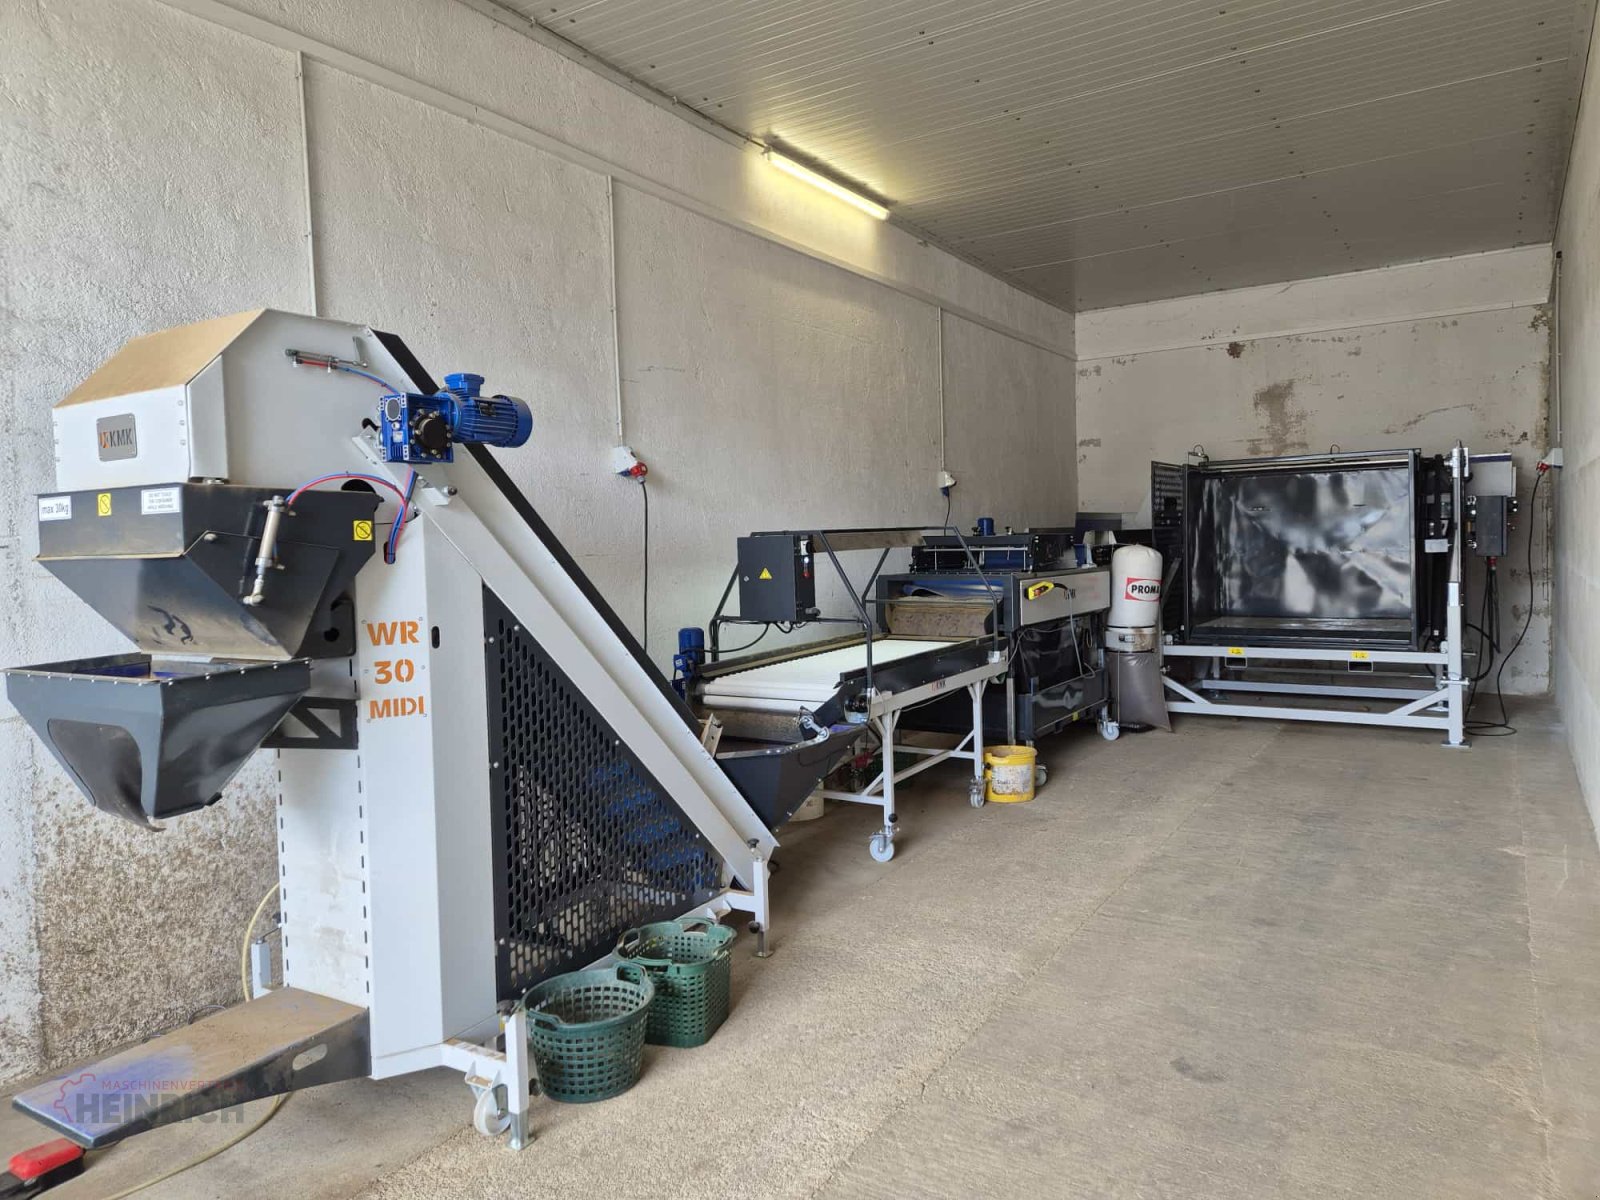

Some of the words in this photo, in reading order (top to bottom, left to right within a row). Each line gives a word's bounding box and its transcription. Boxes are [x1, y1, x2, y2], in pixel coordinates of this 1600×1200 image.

[41, 506, 54, 514] max
[366, 621, 419, 646] WR
[374, 659, 414, 684] 30
[369, 696, 424, 719] MIDI
